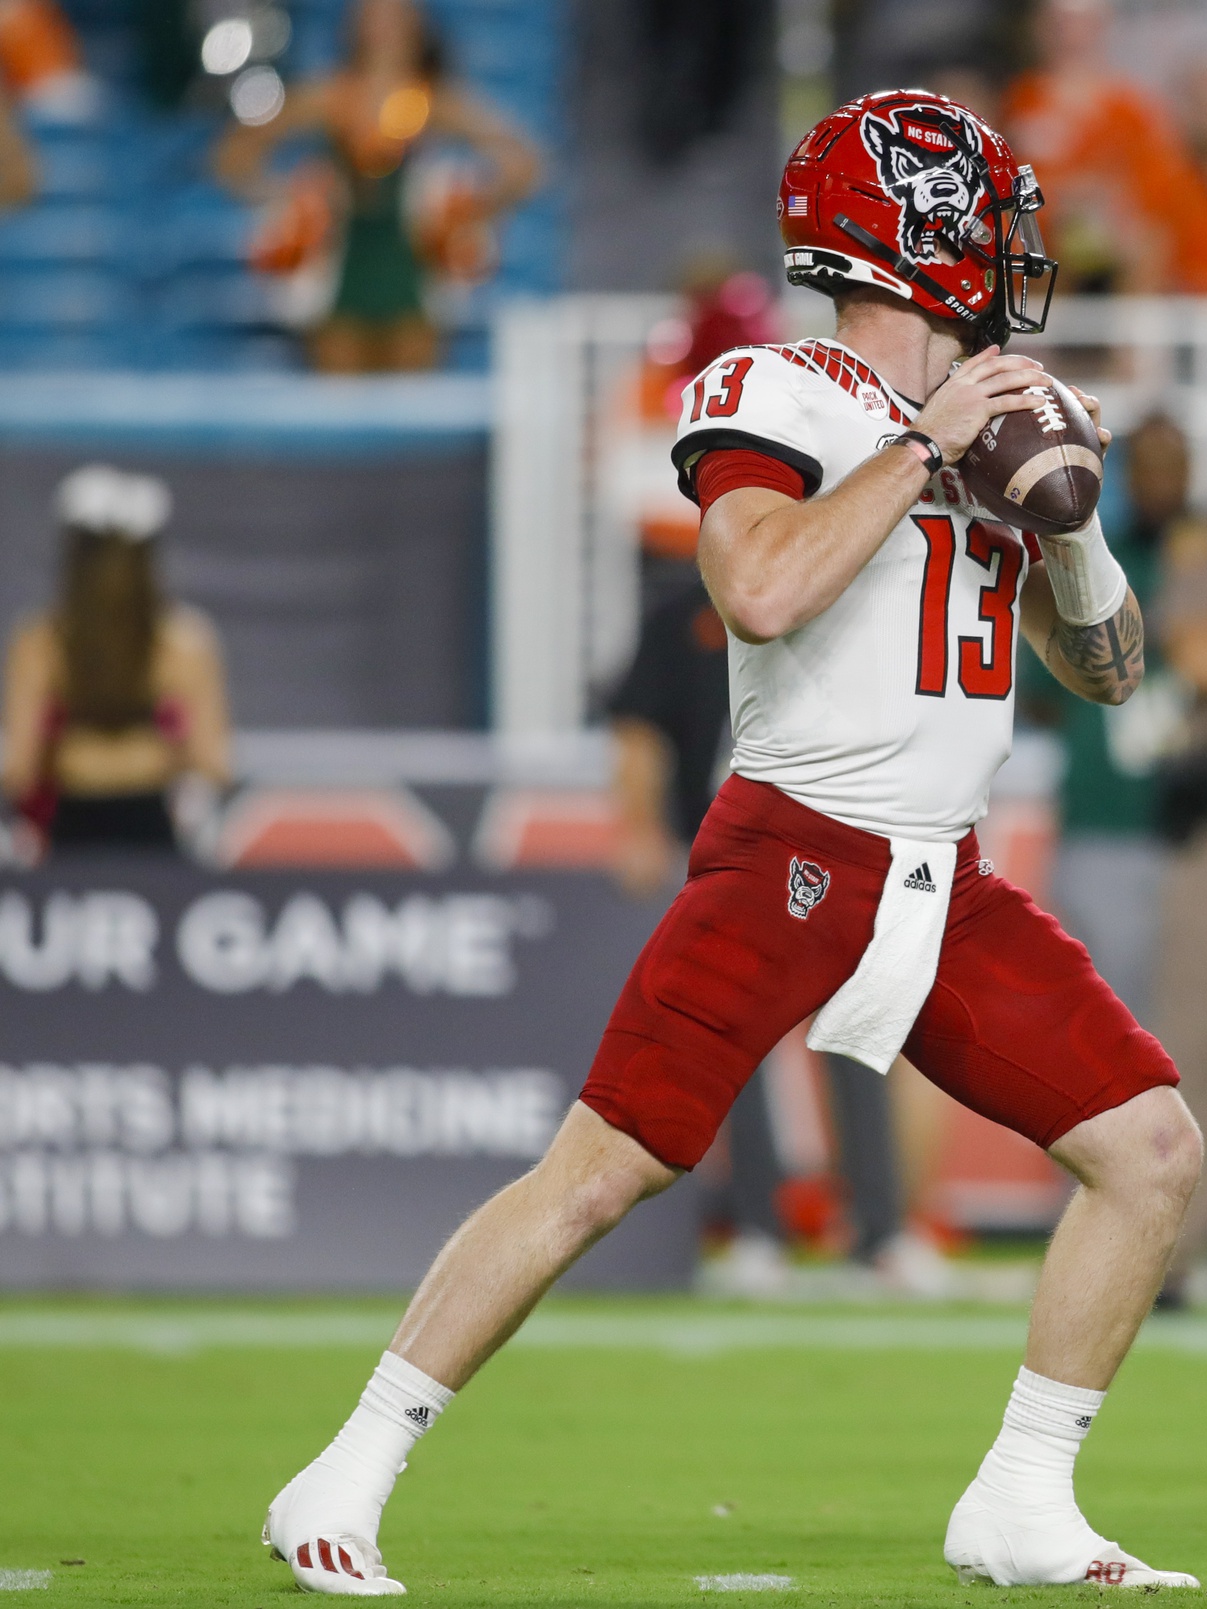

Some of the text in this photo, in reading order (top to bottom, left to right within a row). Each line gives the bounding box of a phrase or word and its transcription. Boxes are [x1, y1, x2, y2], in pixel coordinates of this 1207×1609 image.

[908, 125, 922, 140] NC
[690, 357, 754, 424] 13
[861, 390, 878, 402] PACK
[863, 399, 885, 412] UNITED
[909, 514, 1025, 701] 13
[904, 878, 937, 893] adidas
[177, 891, 515, 996] GAME
[0, 1063, 563, 1158] RTS MEDICINE
[0, 1152, 295, 1239] TITUTE
